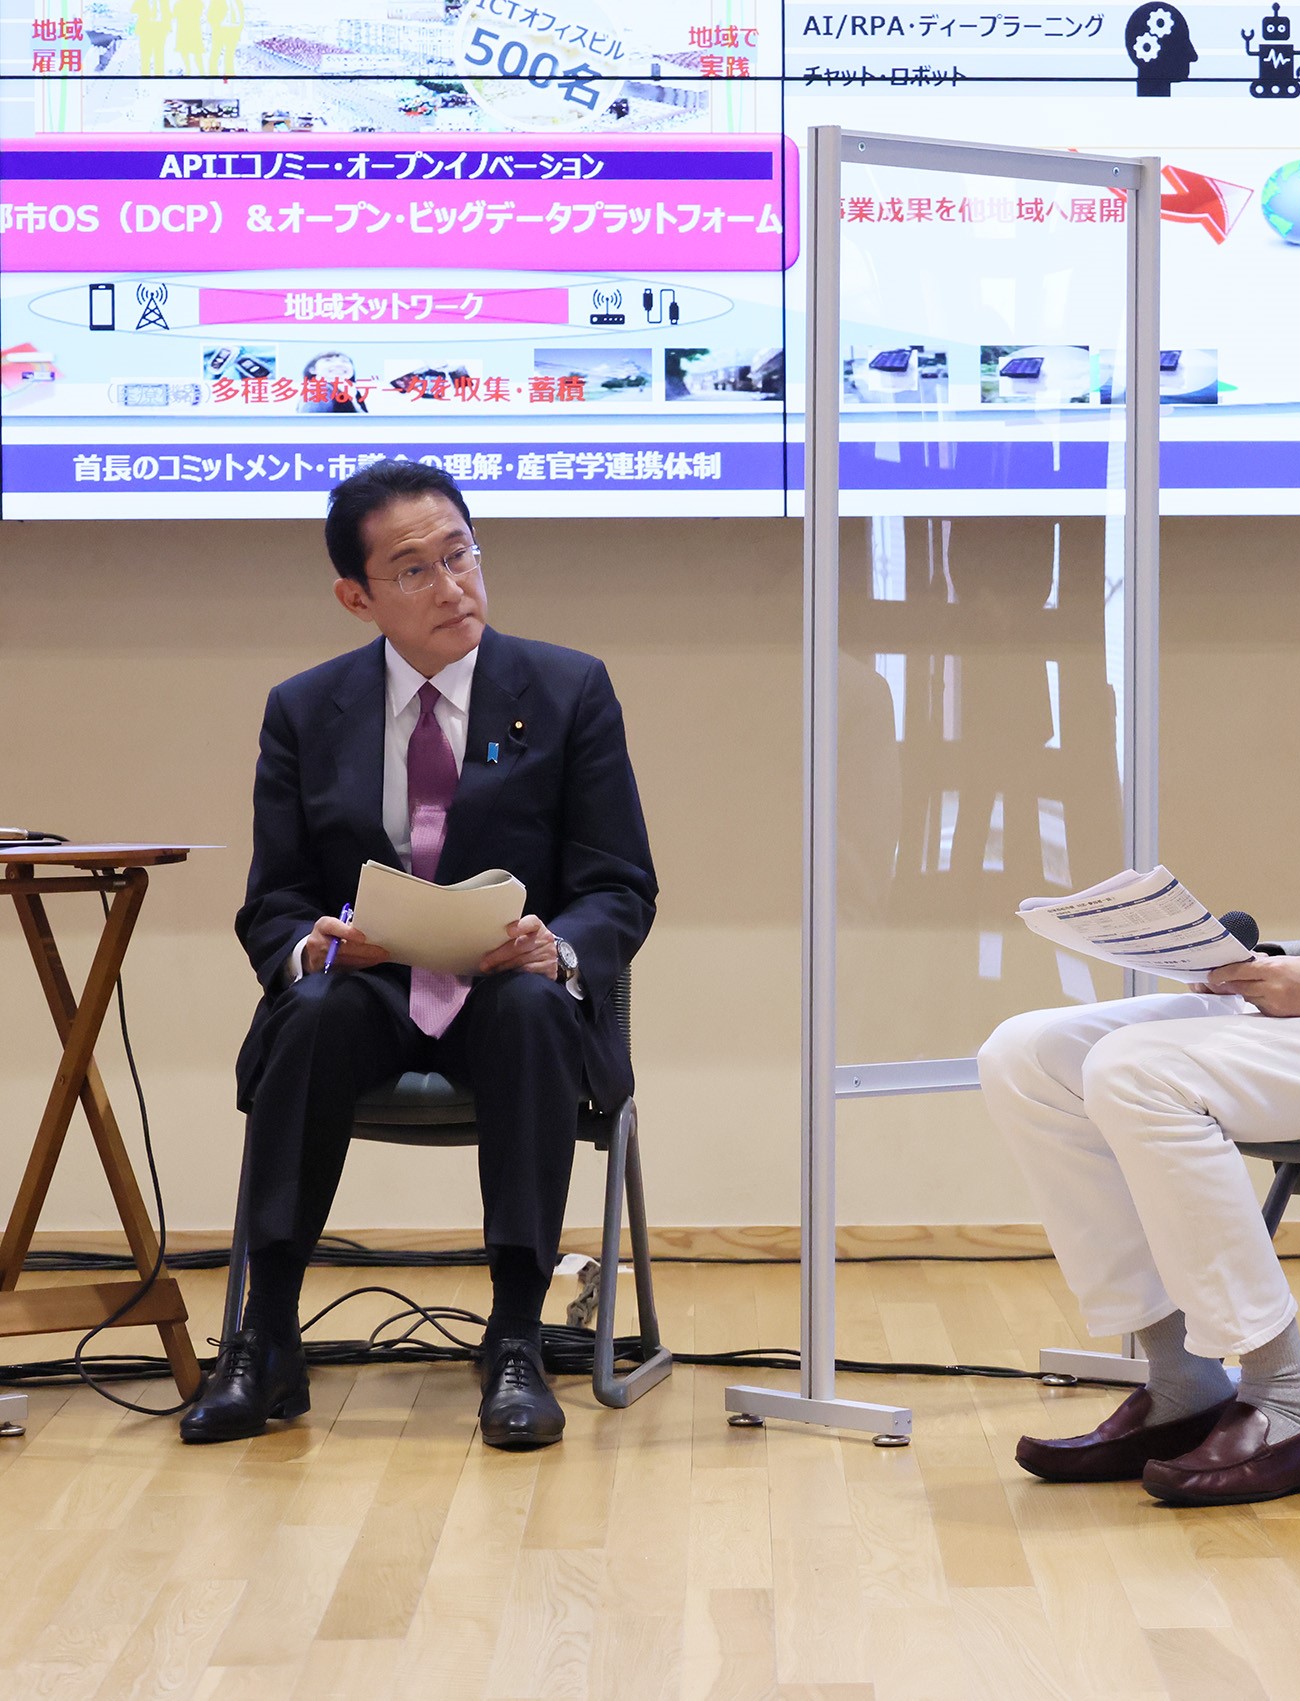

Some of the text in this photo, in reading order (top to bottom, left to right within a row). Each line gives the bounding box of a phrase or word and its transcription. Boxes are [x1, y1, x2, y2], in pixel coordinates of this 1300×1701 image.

[32, 18, 83, 42] 地域
[688, 25, 760, 48] 地域で
[803, 13, 1104, 39] AI/RPA・ディープラーニング
[32, 49, 82, 73] 雇用
[464, 26, 602, 111] 500名
[699, 54, 751, 78] 実践
[803, 65, 967, 87] チャット・ロボット
[159, 152, 605, 181] APIエコノミー・オープンイノベーション
[840, 196, 1126, 224] 業成果を他地域へ展開
[284, 292, 484, 321] 地域ネットワーク
[212, 376, 587, 404] 多種多様なデータを収集・蓄積
[73, 451, 722, 482] 首長のコミットメント・市の理解・産官学連携体制
